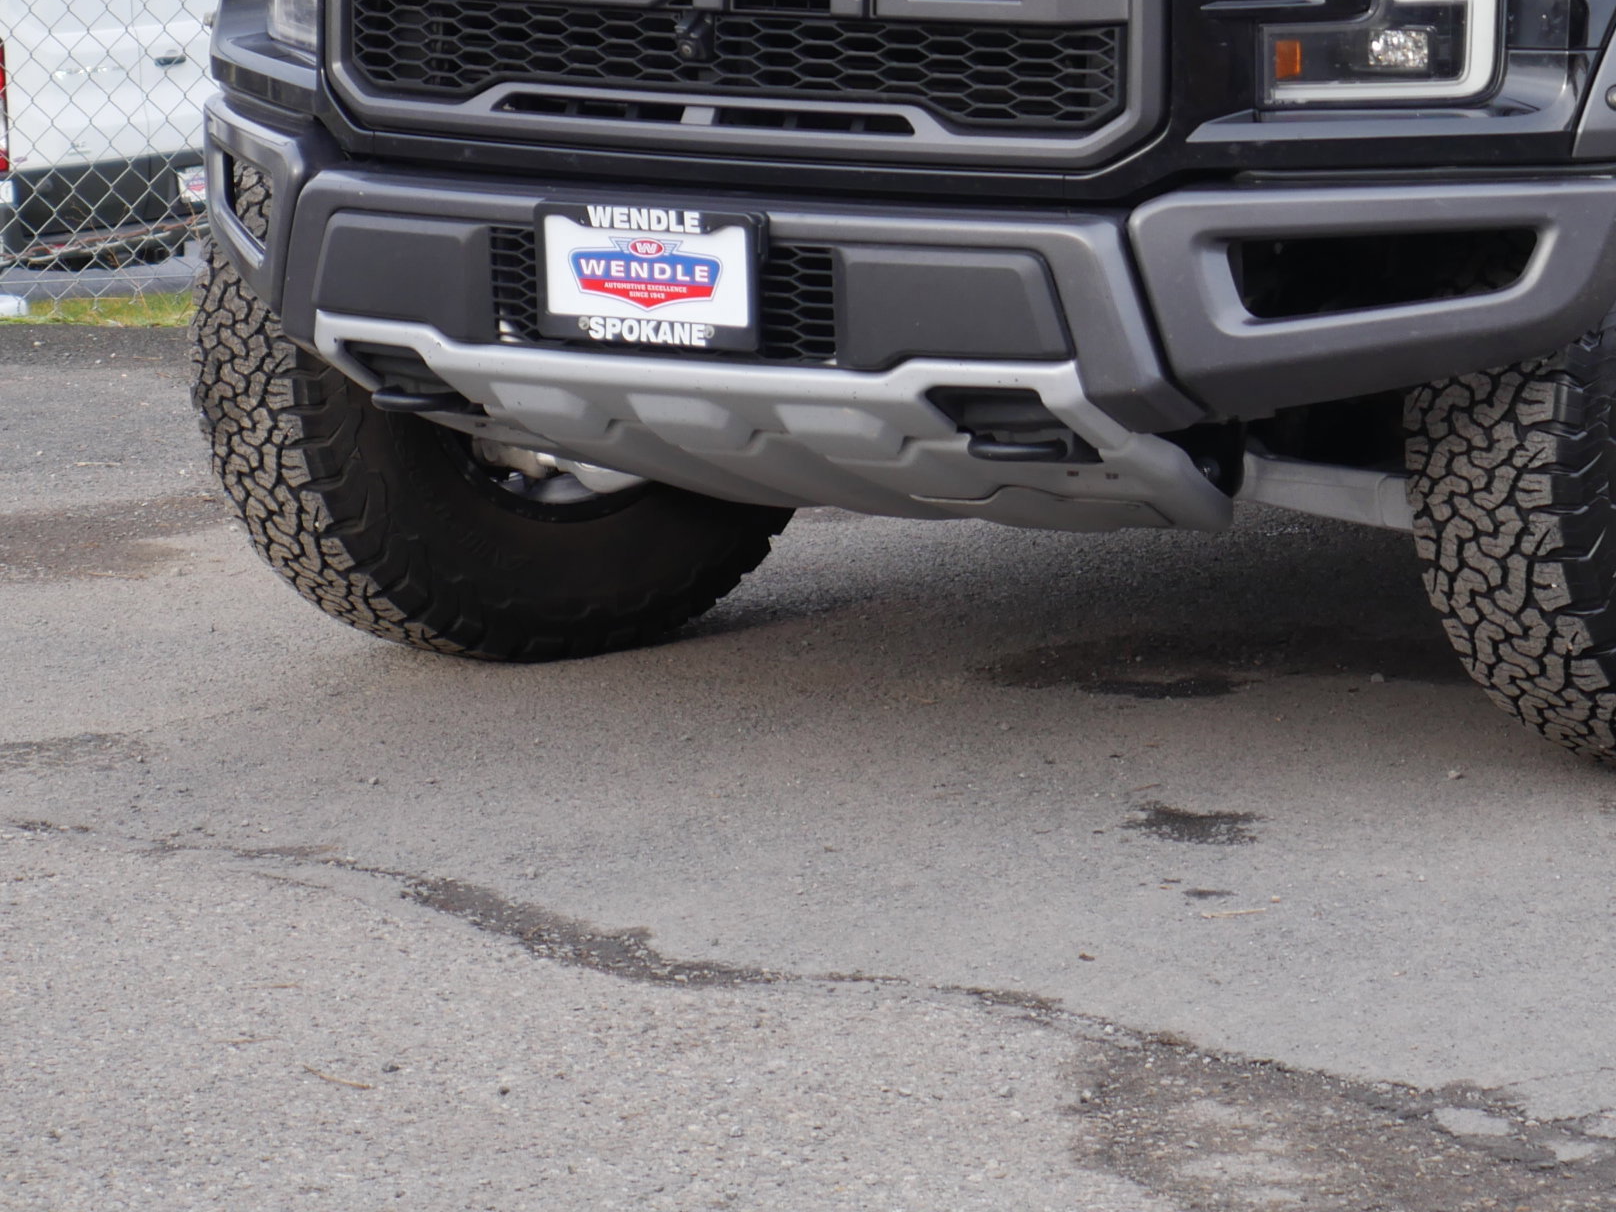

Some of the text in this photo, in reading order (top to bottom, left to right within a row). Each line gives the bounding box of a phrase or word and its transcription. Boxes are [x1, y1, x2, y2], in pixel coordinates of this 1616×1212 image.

[587, 205, 701, 234] WENDLE
[579, 258, 709, 283] WENDLE
[604, 282, 688, 294] AUTOMOTIVE EXCELLENCE
[629, 291, 649, 299] SINCE
[588, 316, 707, 346] SPOKANE
